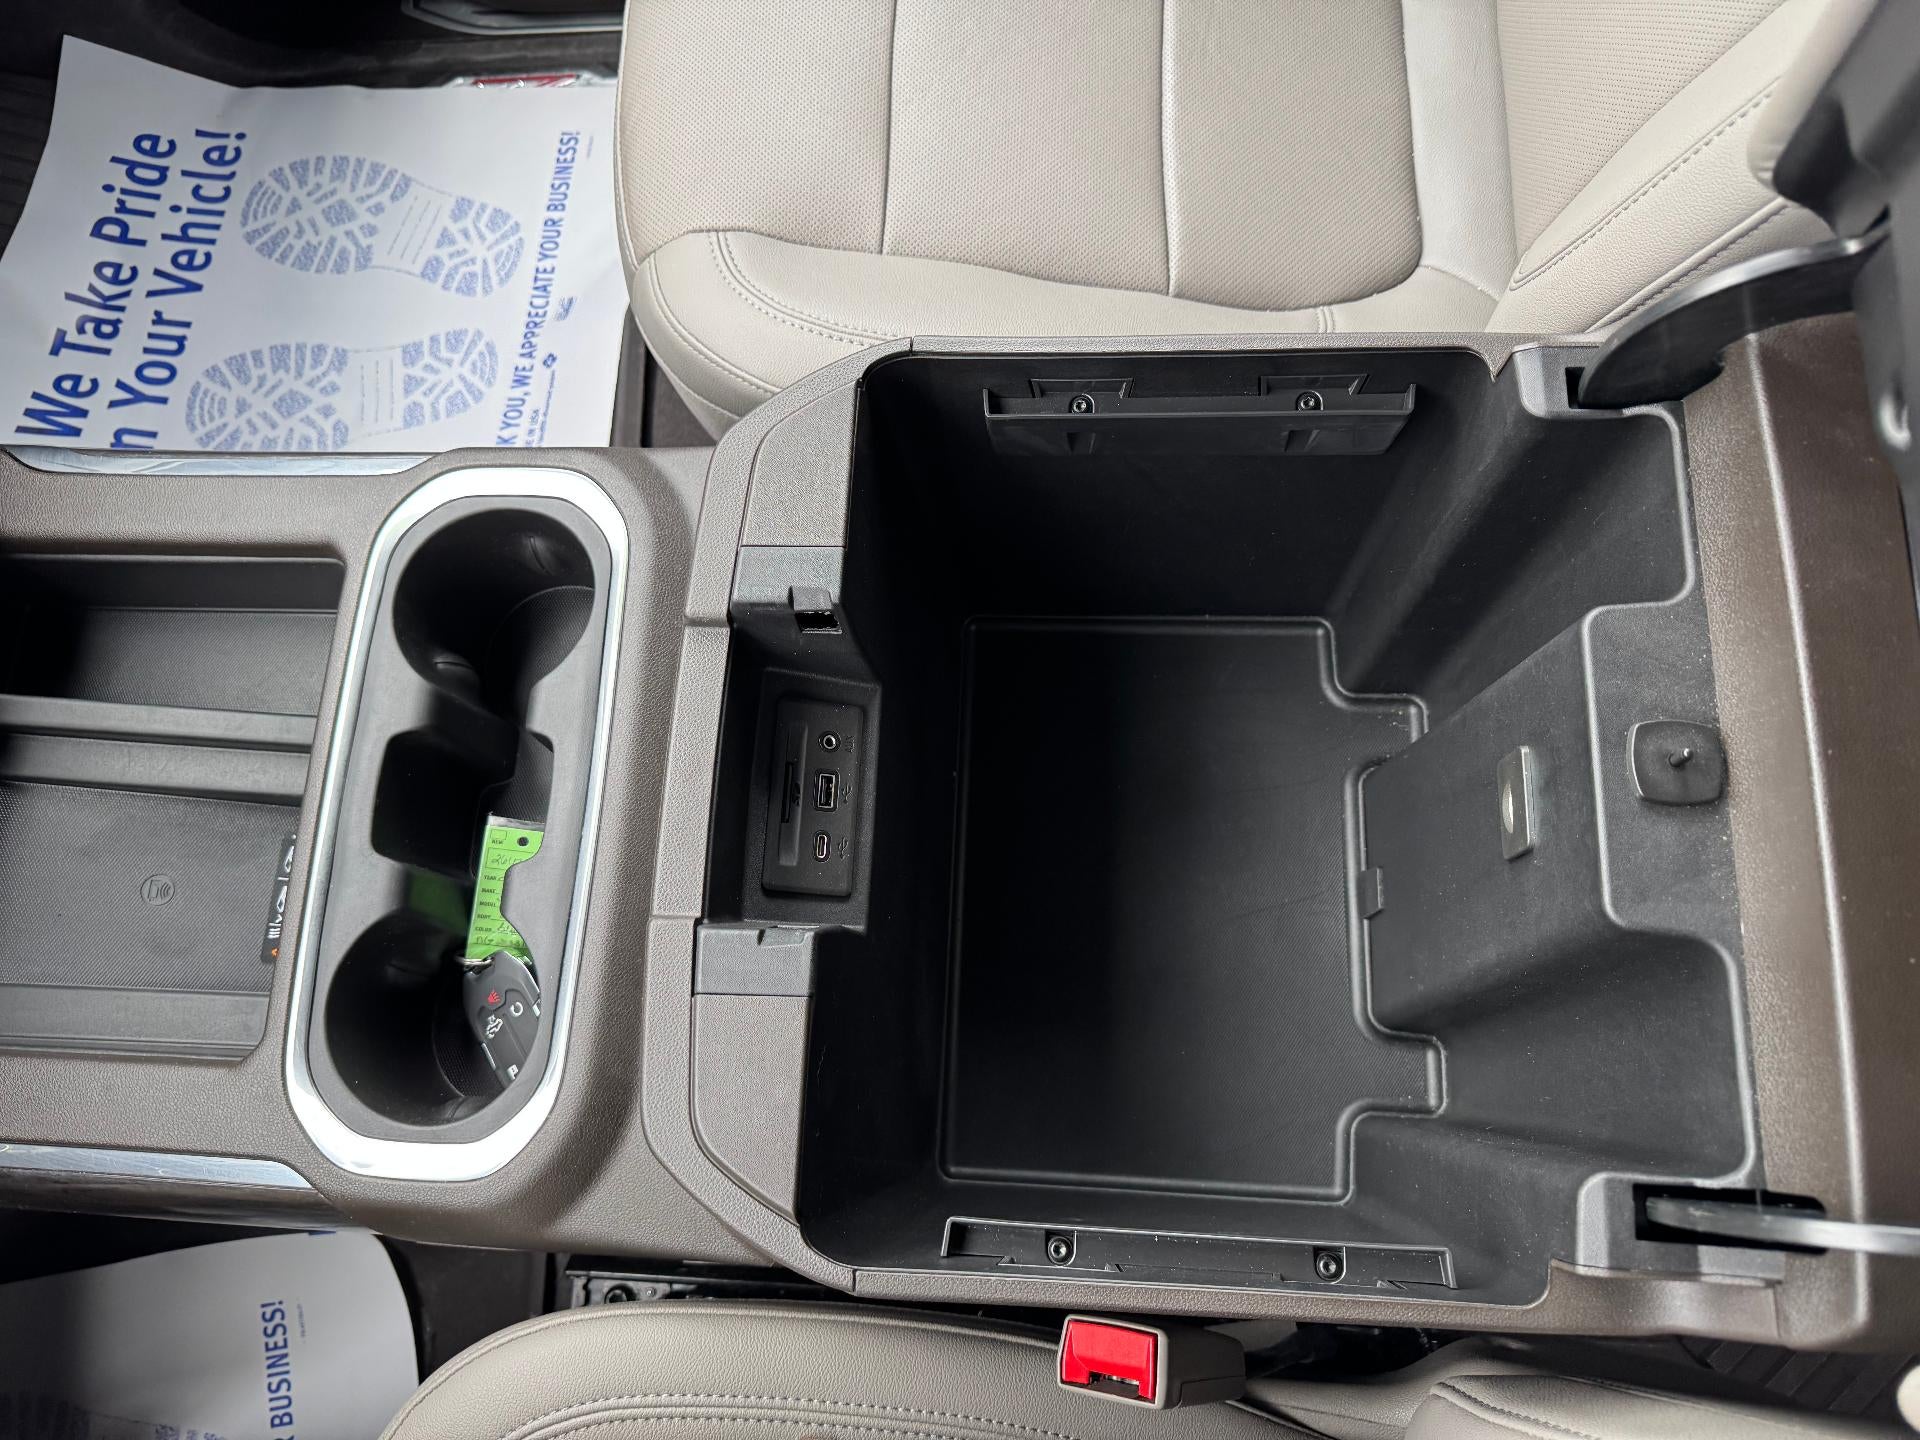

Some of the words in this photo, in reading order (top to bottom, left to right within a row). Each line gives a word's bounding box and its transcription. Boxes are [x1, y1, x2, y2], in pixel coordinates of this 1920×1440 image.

[89, 134, 177, 247] Pride
[145, 129, 247, 298] Vehicle!
[547, 131, 580, 212] BUSINESS!
[537, 218, 564, 262] YOUR
[49, 261, 139, 356] Take
[519, 266, 556, 359] APPRECIATE
[15, 374, 99, 437] We
[107, 310, 192, 410] Your
[511, 365, 534, 389] WE
[501, 391, 531, 431] YOU,
[260, 1300, 294, 1428] BUSINESS!
